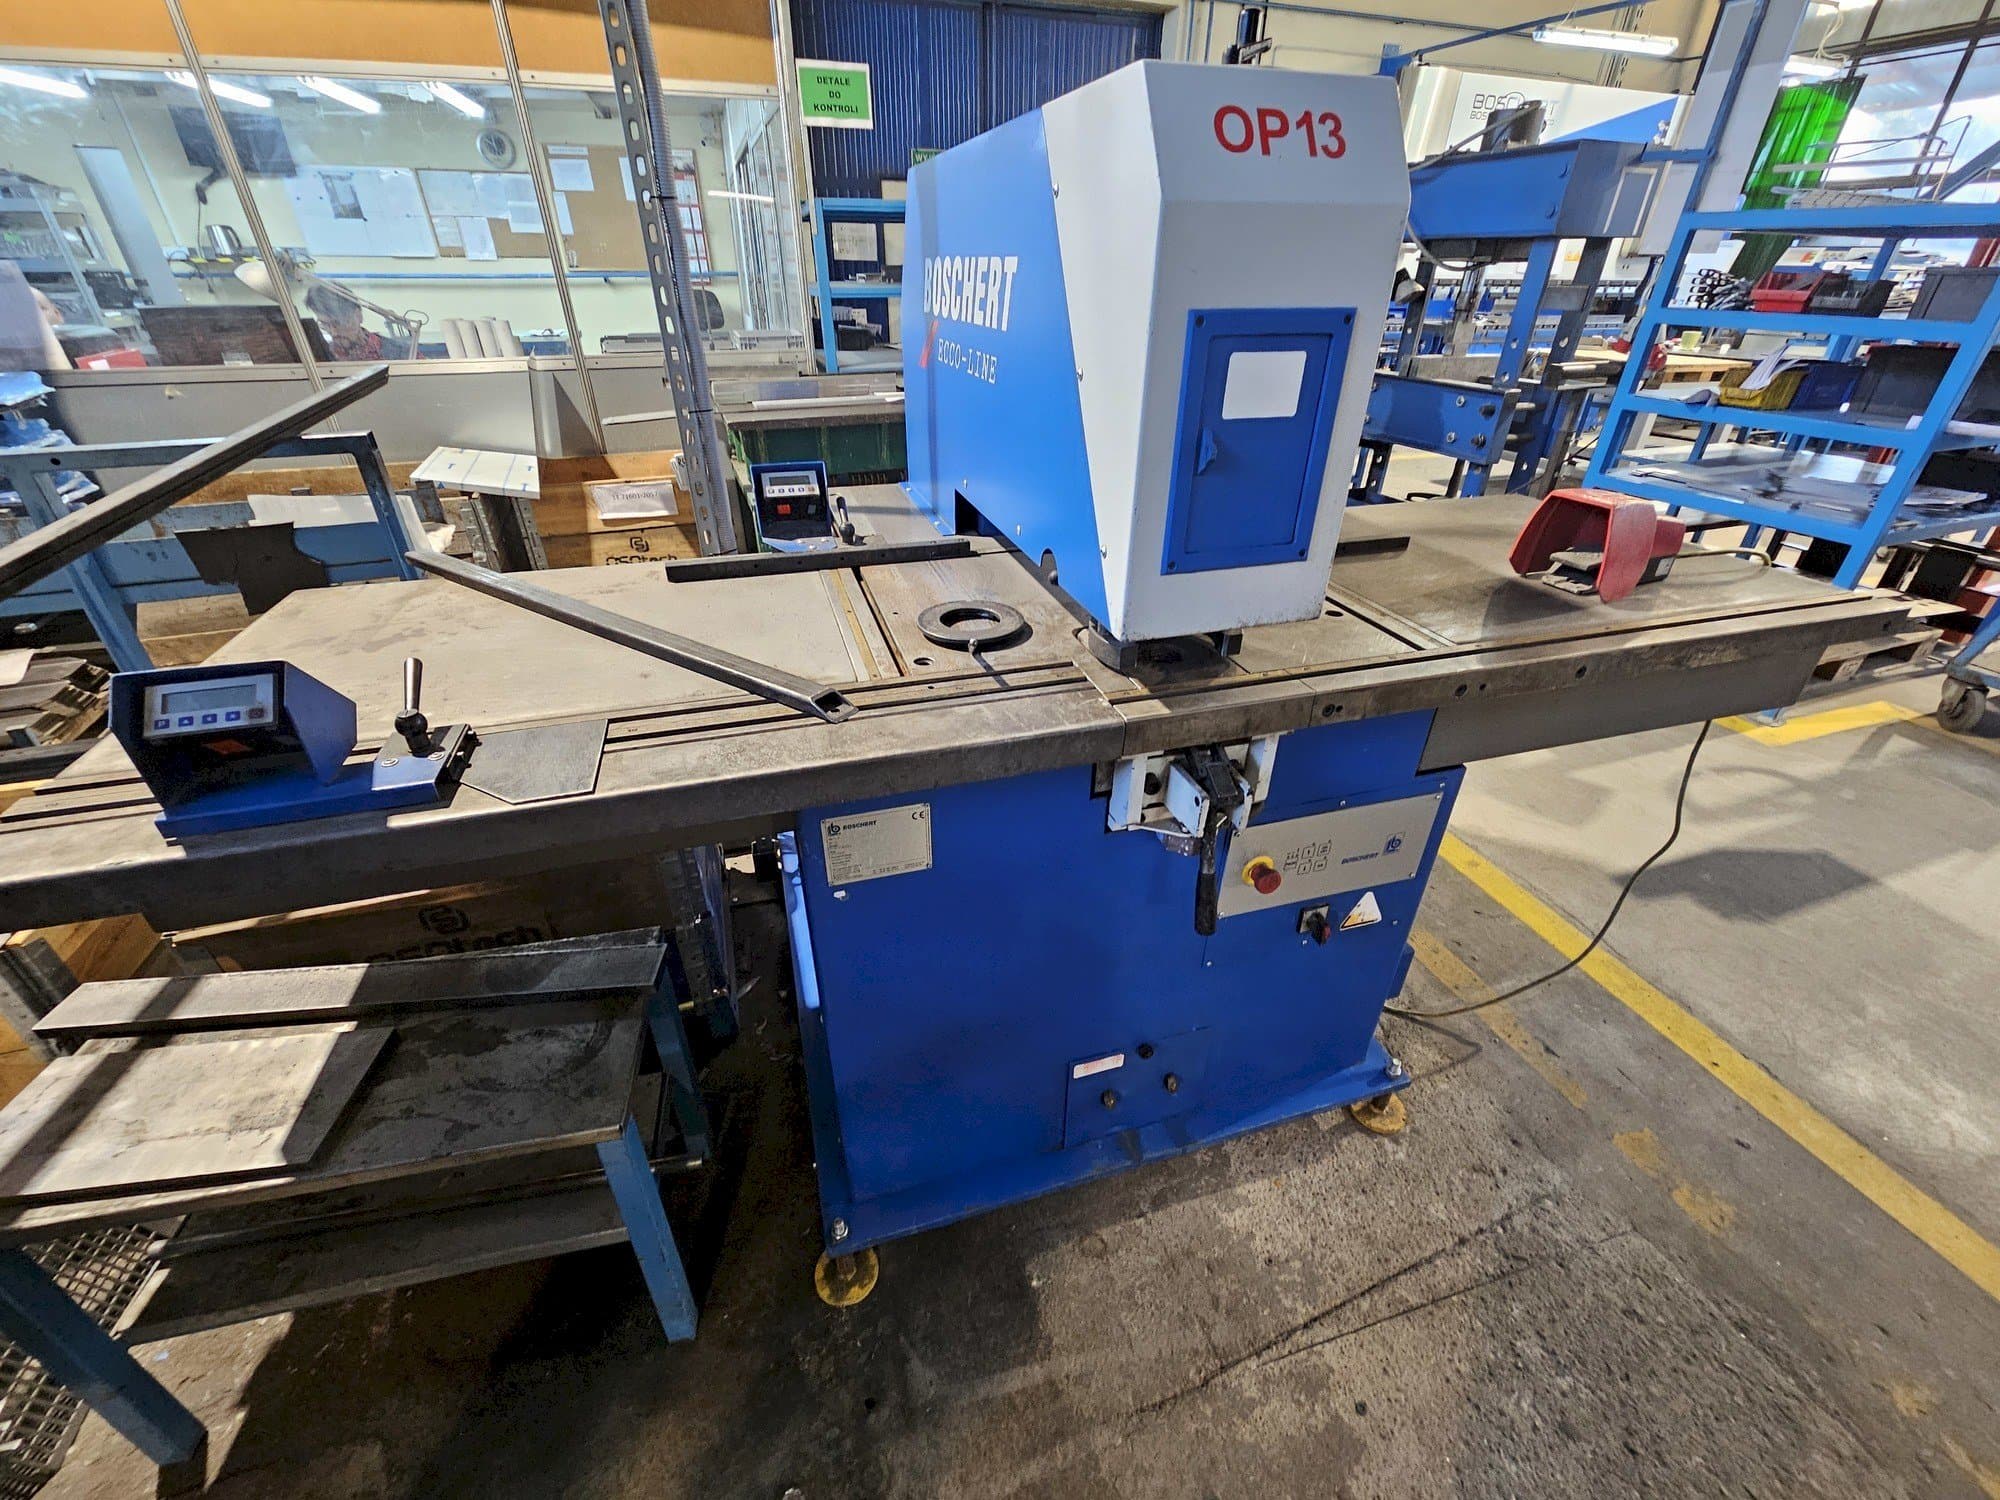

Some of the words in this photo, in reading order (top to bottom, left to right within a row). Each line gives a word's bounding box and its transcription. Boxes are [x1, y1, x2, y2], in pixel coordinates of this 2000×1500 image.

[816, 75, 851, 86] DETALE
[828, 90, 841, 99] DO
[813, 103, 859, 113] KONTROLI
[1472, 93, 1561, 116] BOSCT
[923, 255, 1018, 332] BOSCHERT
[938, 338, 997, 385] ECCO-LINE
[842, 820, 877, 831] BOSCHERT
